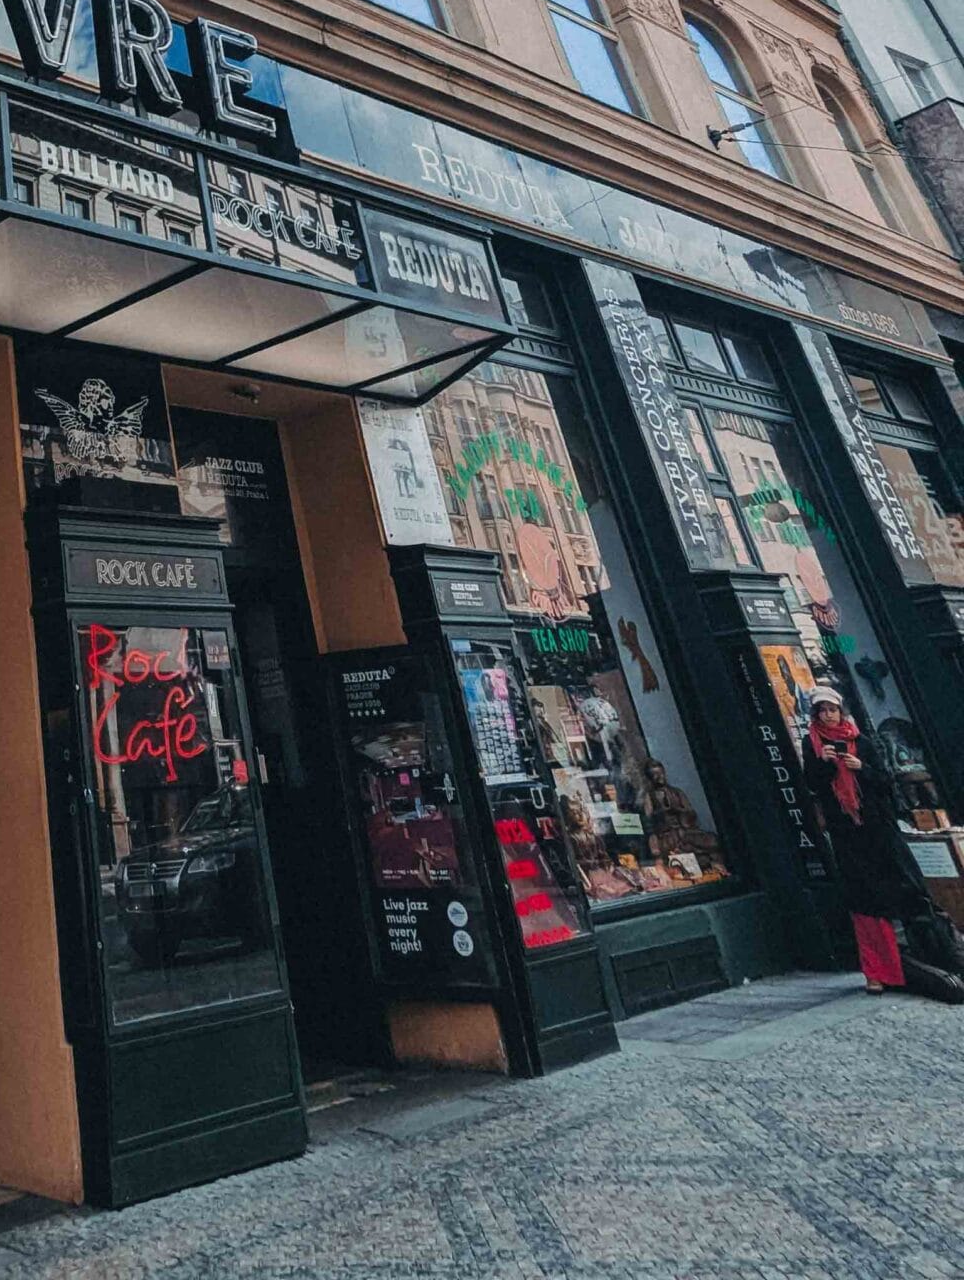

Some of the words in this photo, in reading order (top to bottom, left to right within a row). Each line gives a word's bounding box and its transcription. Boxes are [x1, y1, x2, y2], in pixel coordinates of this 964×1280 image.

[40, 139, 175, 203] BILLIARD
[412, 142, 574, 230] REDUTA
[210, 190, 291, 243] ROCK
[379, 230, 490, 302] REDUTA
[602, 287, 670, 452] CONCERTS
[631, 320, 668, 387] DAY
[204, 456, 233, 471] JAZZ
[234, 459, 265, 474] CLUB
[657, 392, 712, 510] EVERY
[664, 460, 707, 546] LIVE
[95, 557, 150, 587] ROCK
[531, 627, 558, 653] TEA
[558, 628, 589, 654] SHOP
[342, 669, 391, 684] REDUTA
[758, 724, 815, 848] REDUTA
[382, 898, 405, 911] Live
[406, 898, 429, 913] jazz
[386, 912, 417, 924] music
[388, 928, 417, 942] every
[390, 938, 423, 955] night!
